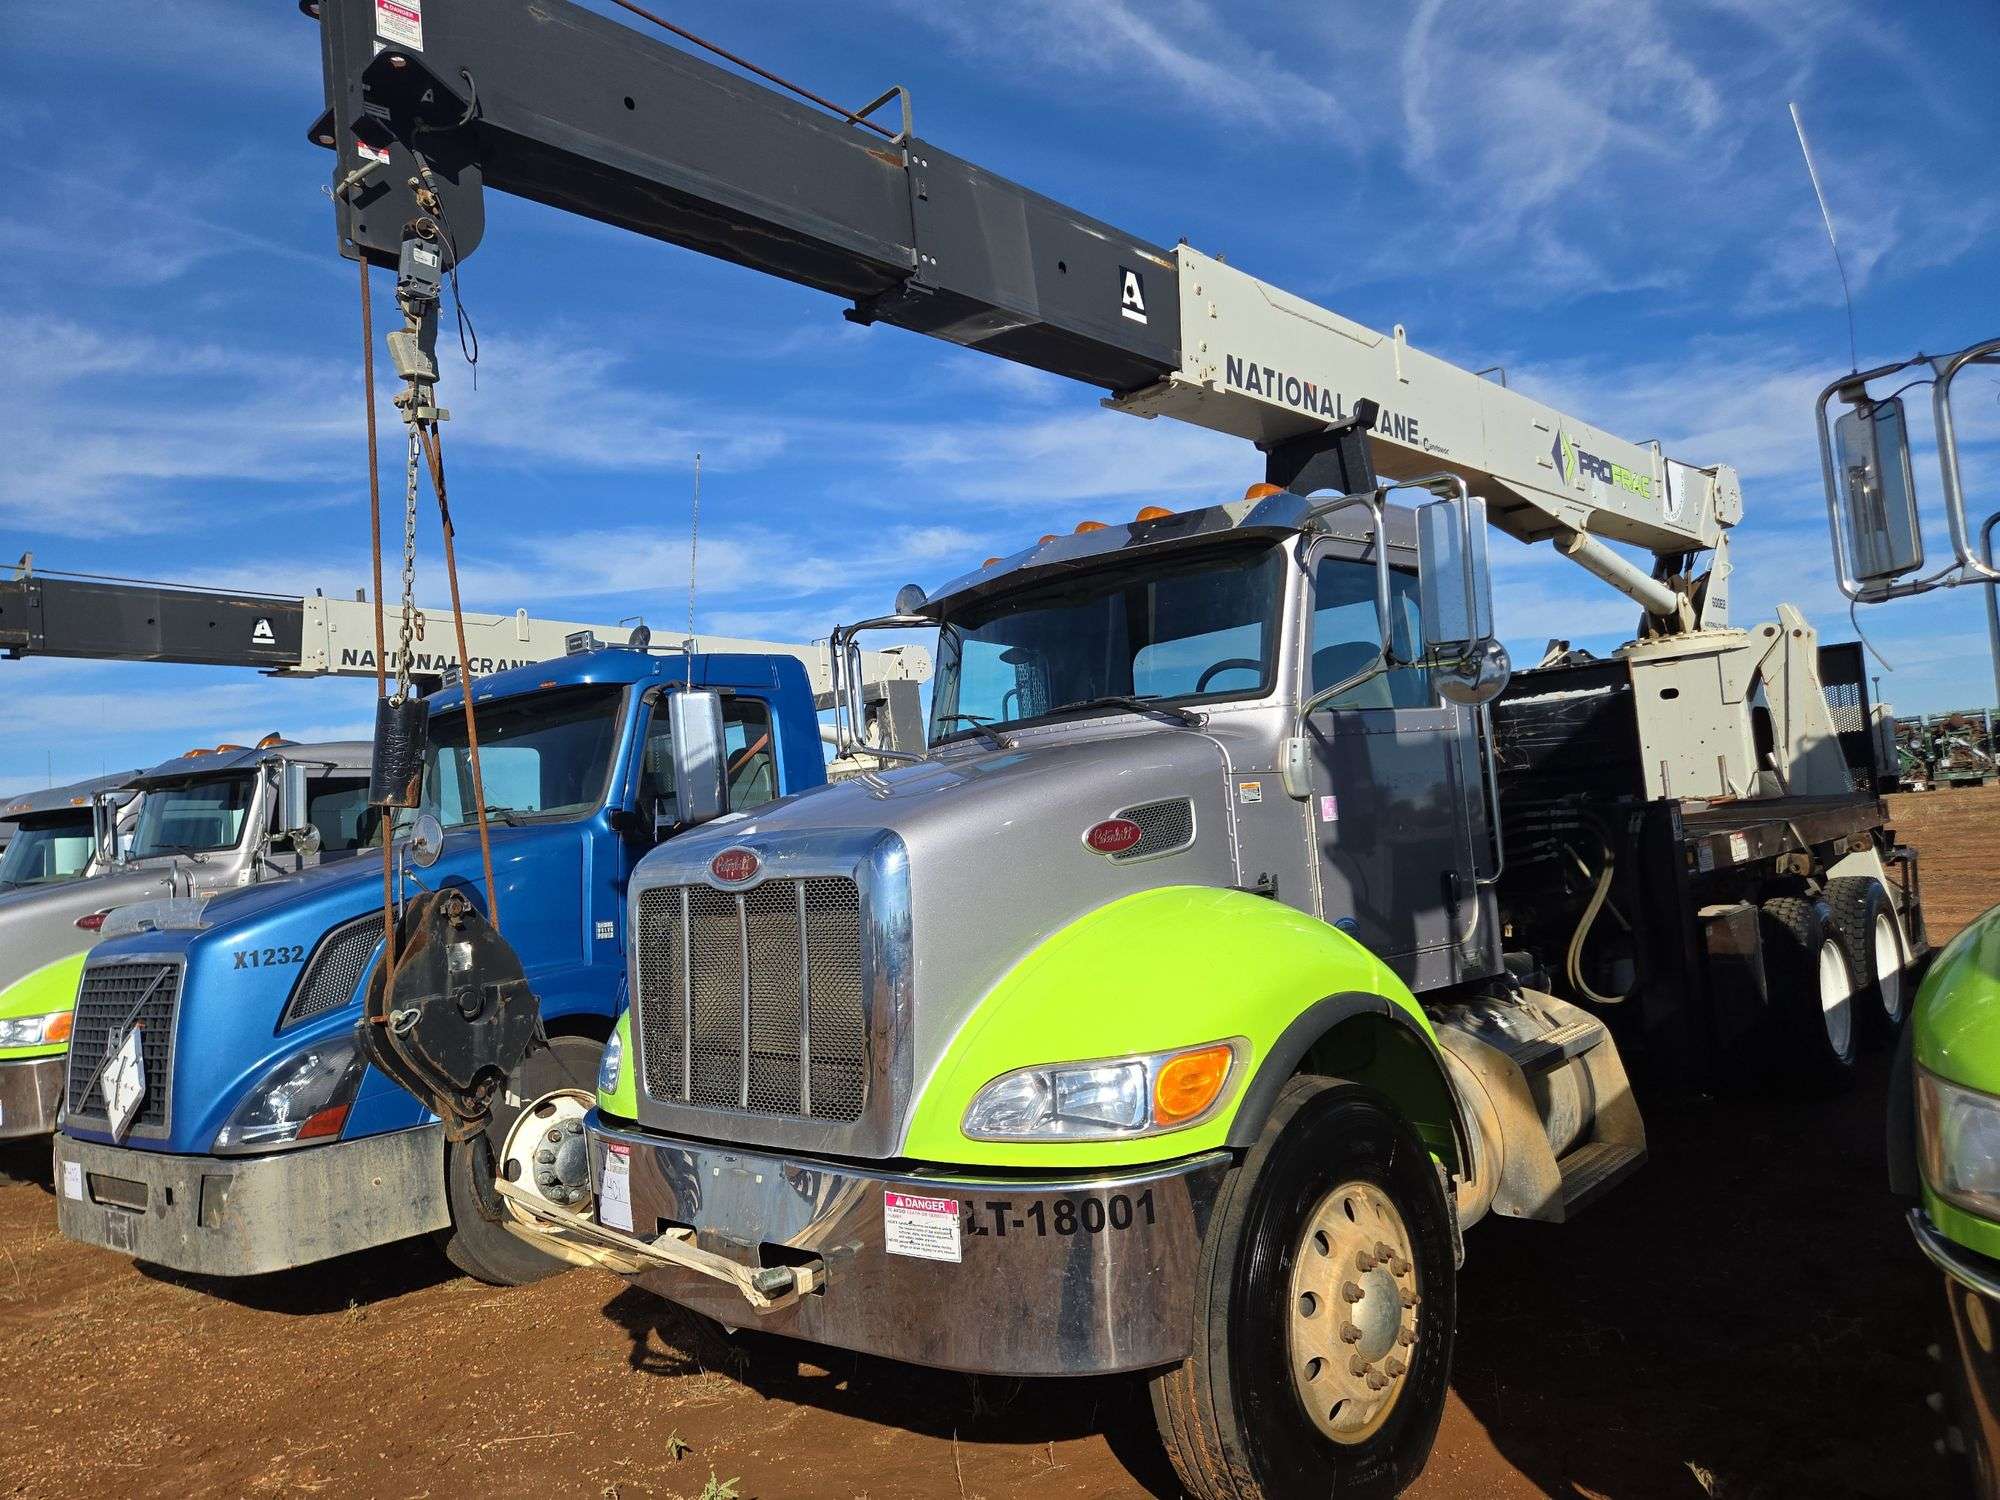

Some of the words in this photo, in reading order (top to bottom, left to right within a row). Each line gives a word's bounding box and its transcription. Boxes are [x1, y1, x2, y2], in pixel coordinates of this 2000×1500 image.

[1226, 354, 1347, 421] NATIONAL
[1353, 400, 1419, 445] ANE
[468, 657, 537, 673] CRAN
[233, 945, 305, 969] X1232
[904, 1197, 946, 1211] DANGER
